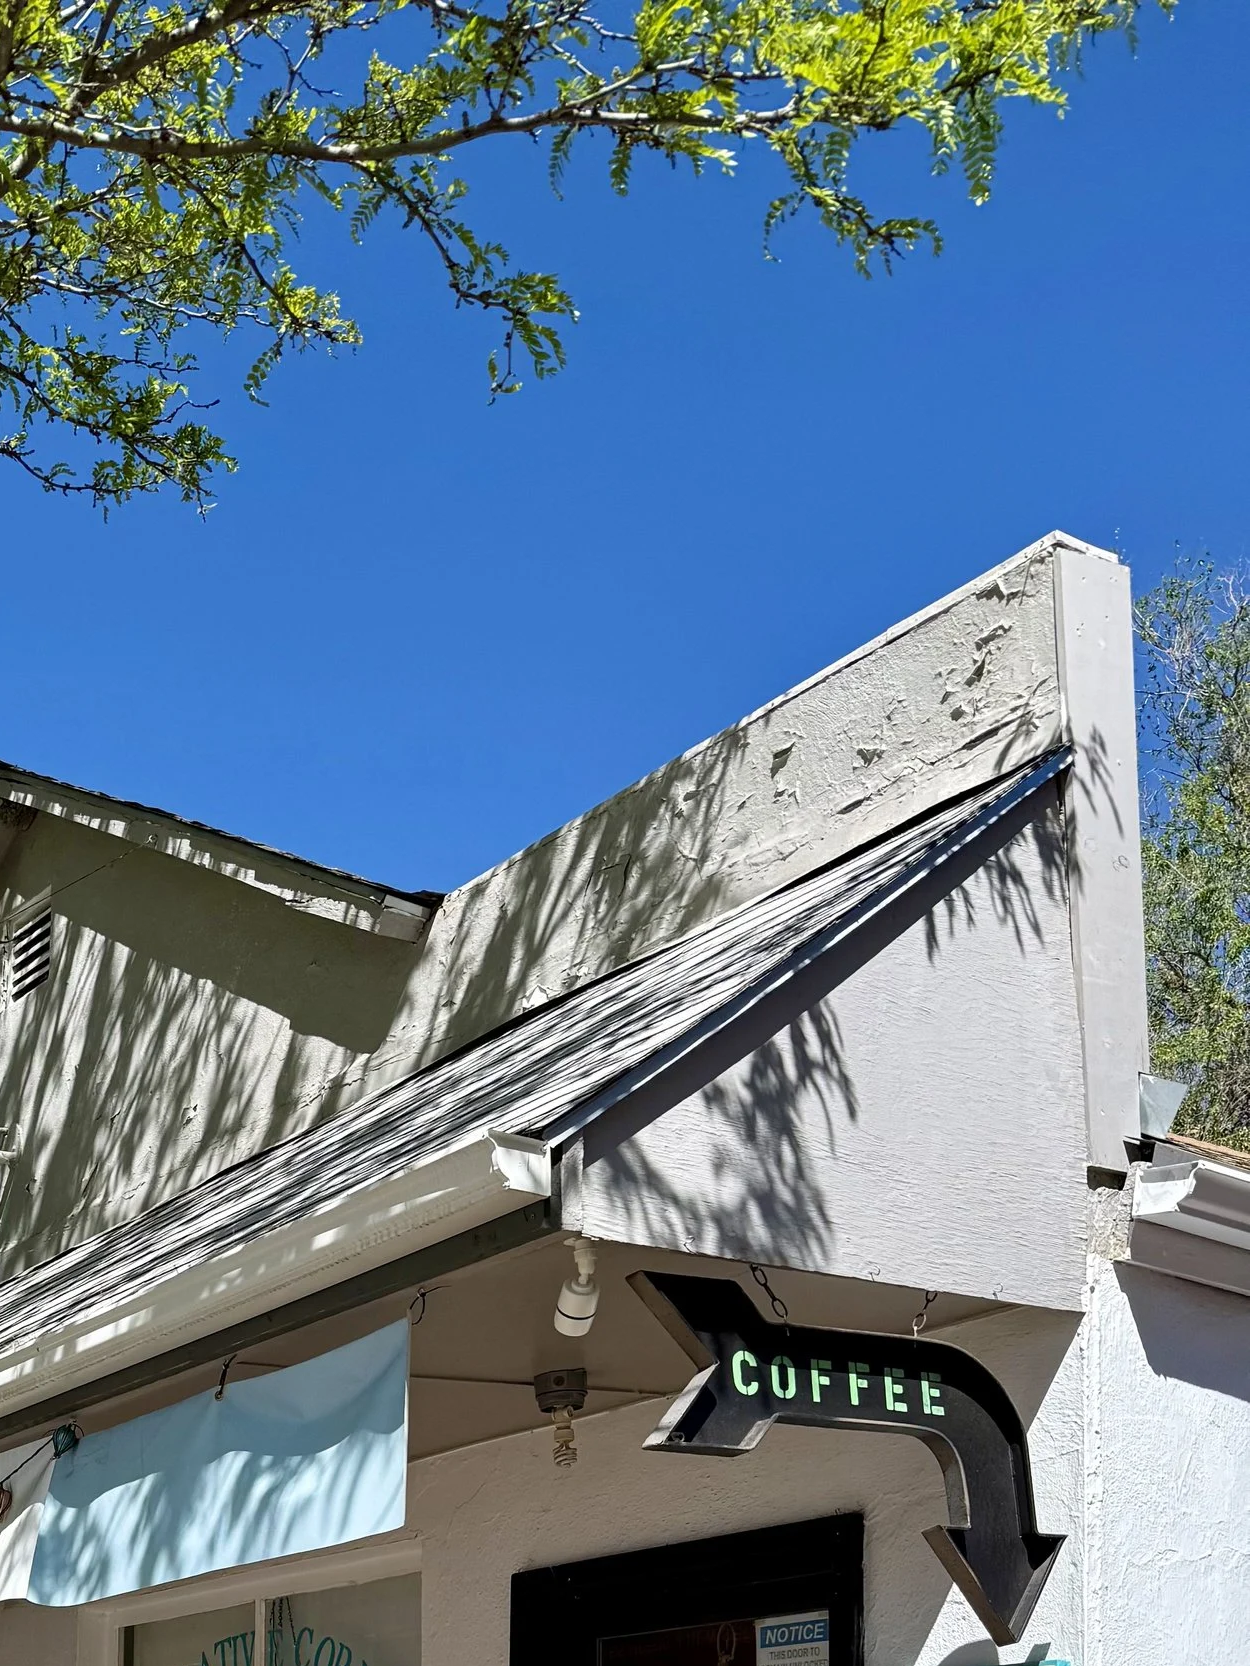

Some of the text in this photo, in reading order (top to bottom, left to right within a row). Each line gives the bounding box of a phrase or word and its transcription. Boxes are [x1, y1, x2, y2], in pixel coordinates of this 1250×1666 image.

[732, 1350, 945, 1416] COFFEE
[765, 1622, 825, 1645] NOTICE
[769, 1646, 821, 1661] THIS DOOR TO
